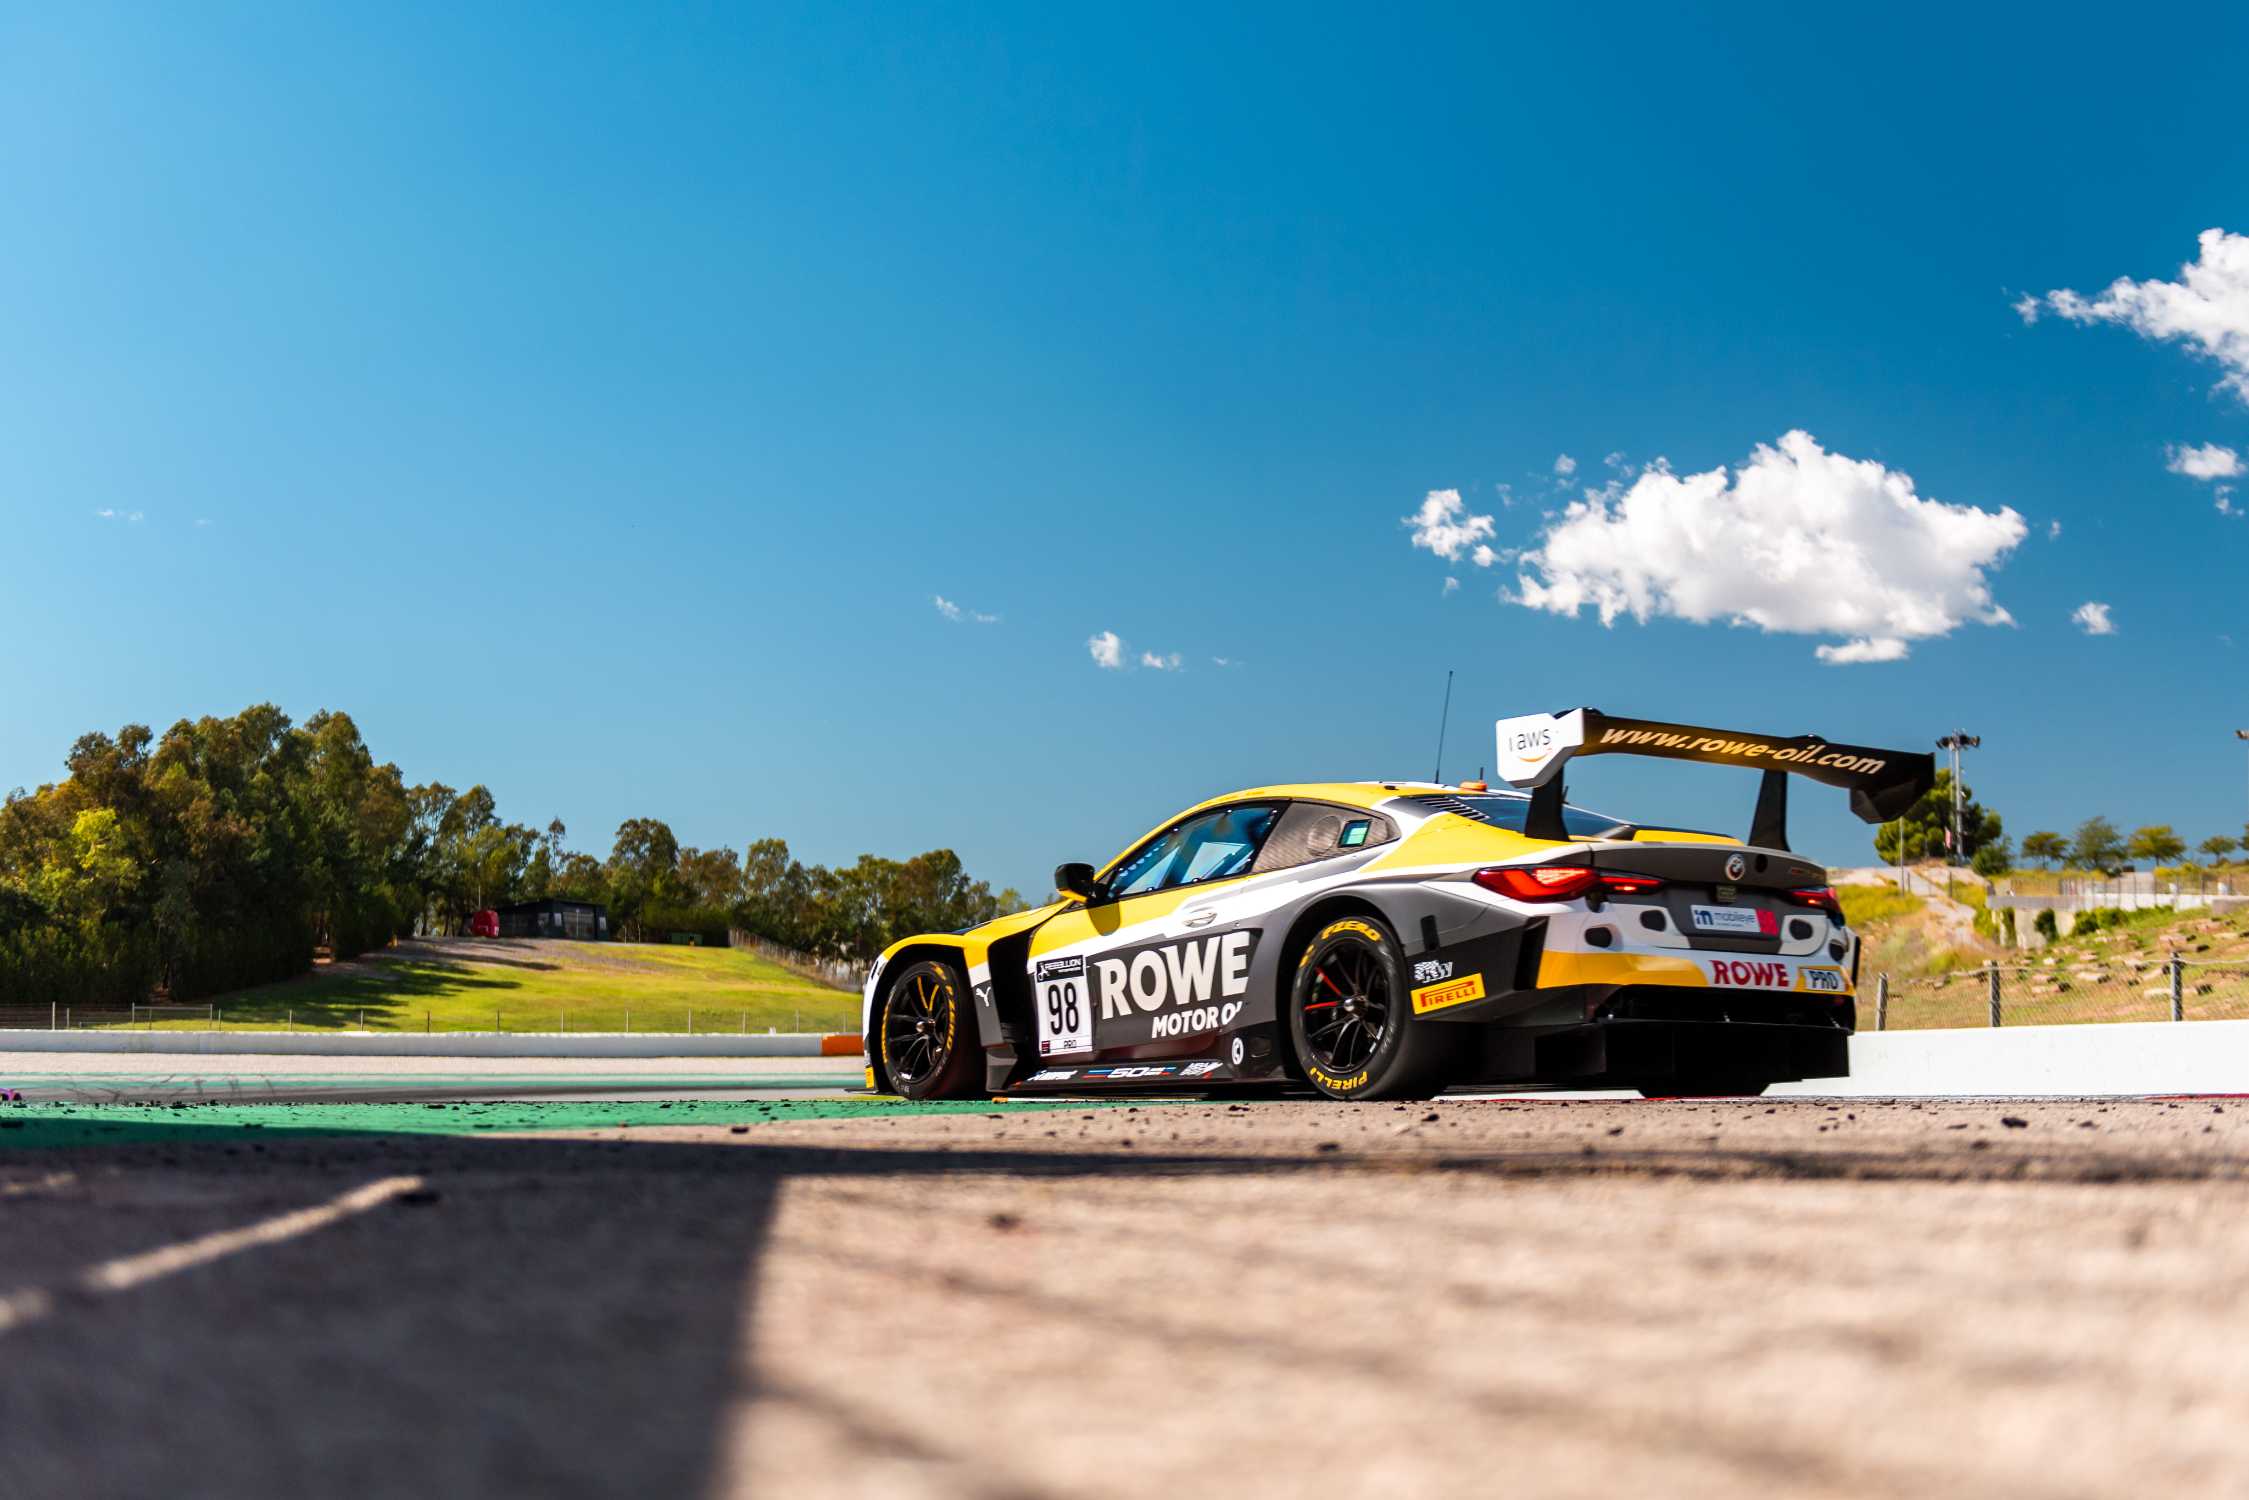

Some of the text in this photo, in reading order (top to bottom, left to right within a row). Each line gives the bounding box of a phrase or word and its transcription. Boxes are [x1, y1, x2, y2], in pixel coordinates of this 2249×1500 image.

[1517, 728, 1551, 750] aws
[1600, 726, 1886, 775] www.rowe-oil.com
[1094, 931, 1249, 1019] ROWE
[1710, 959, 1789, 987] ROWE
[1811, 970, 1839, 990] PRO
[1420, 980, 1476, 1008] PIRELLI
[1048, 982, 1078, 1035] 98
[1152, 1006, 1219, 1038] MOTOR
[1310, 1067, 1368, 1090] PIRELLI
